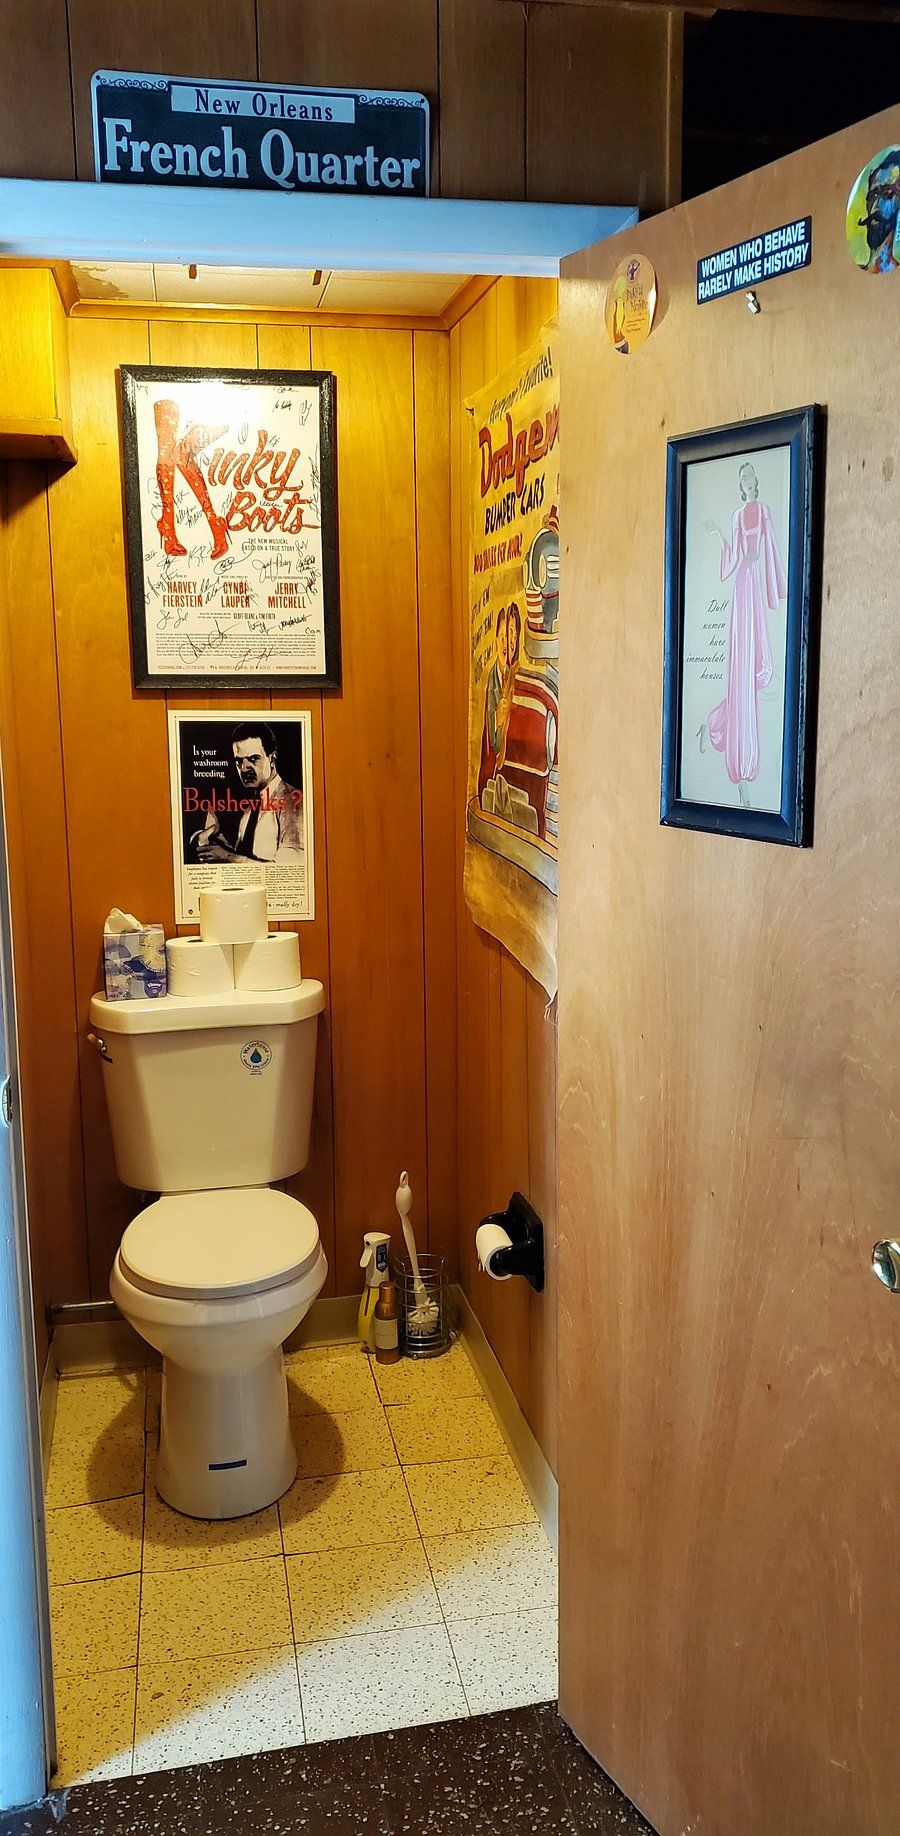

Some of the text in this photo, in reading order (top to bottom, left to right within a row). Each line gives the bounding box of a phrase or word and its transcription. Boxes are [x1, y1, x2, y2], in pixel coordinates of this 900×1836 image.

[195, 88, 333, 121] New Orleans
[102, 117, 421, 189] French Quarter
[701, 221, 805, 278] WOMEN WHO BEHAVE
[698, 242, 809, 300] RARELY MAKE HISTORY
[485, 473, 545, 536] BUMPER CARS
[226, 491, 320, 534] Boots
[167, 581, 197, 594] HARVEY
[223, 582, 247, 594] CYNDI
[275, 582, 299, 595] JERRY
[162, 594, 203, 608] FIERSTEIN
[221, 595, 250, 608] LAUPER
[268, 596, 306, 609] MITCHELL
[709, 634, 726, 646] have
[686, 651, 726, 662] immaculate
[193, 745, 217, 757] Is your
[193, 759, 228, 767] washroom
[193, 770, 225, 779] breeding
